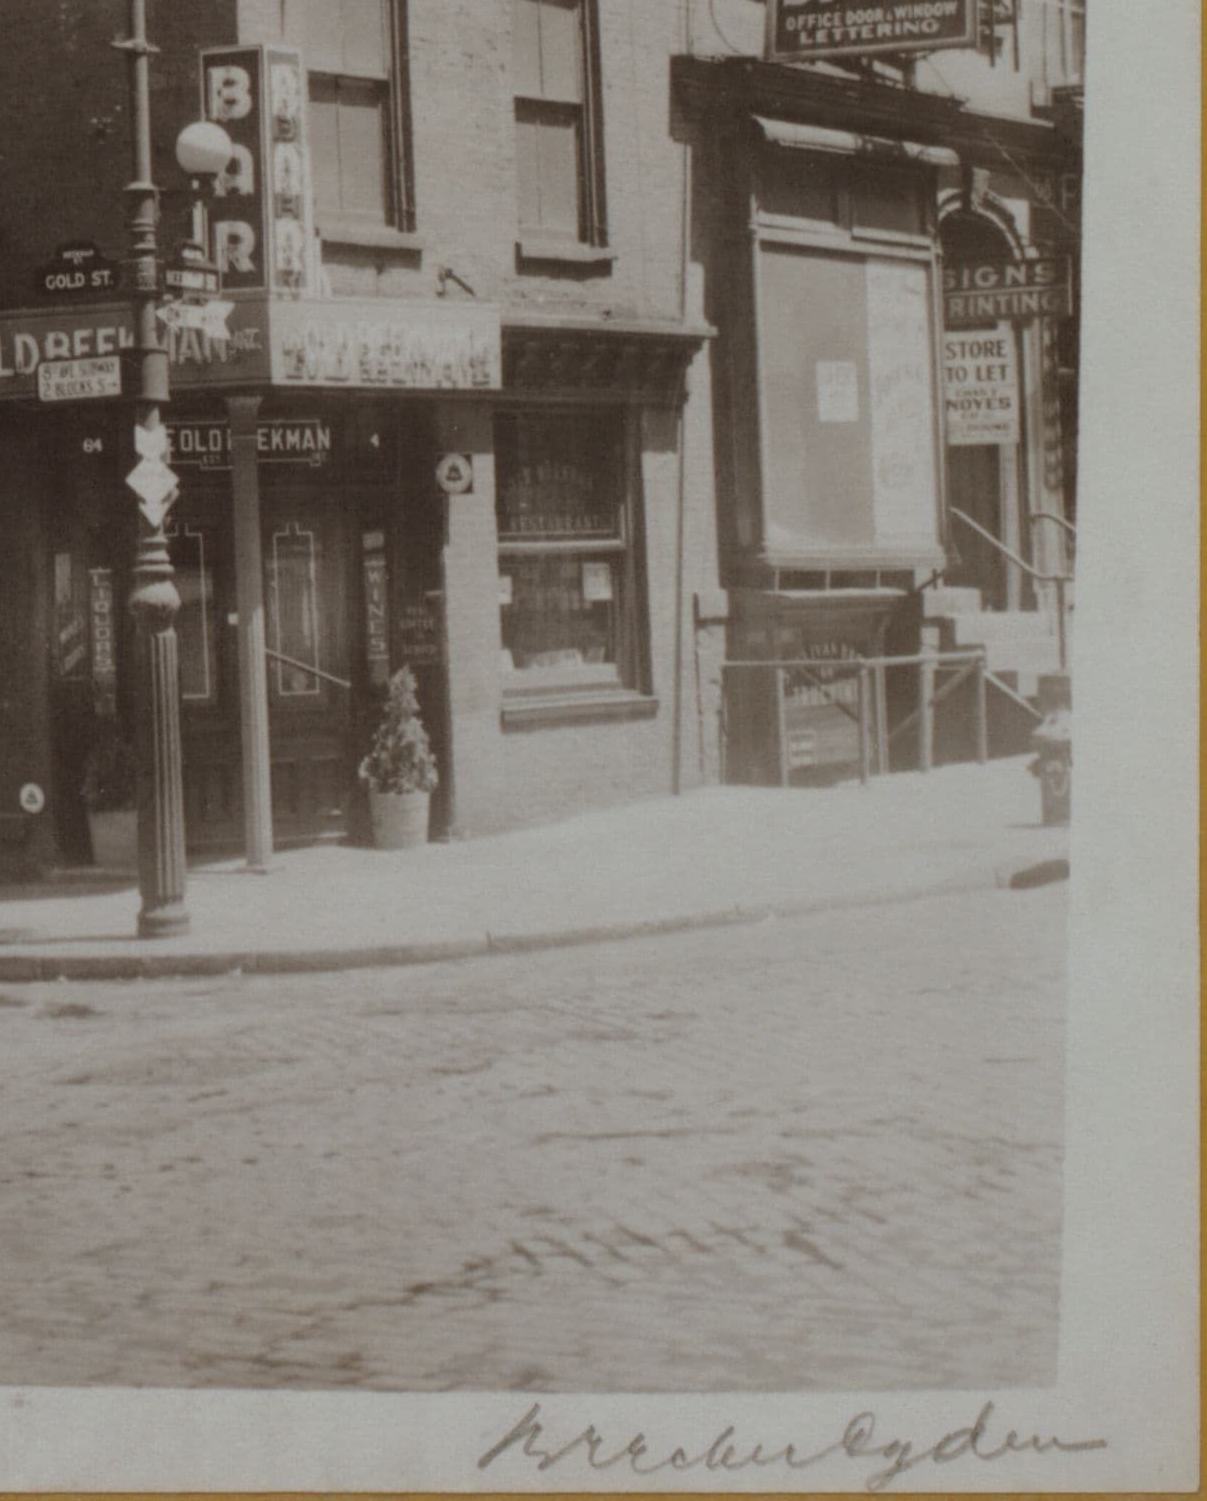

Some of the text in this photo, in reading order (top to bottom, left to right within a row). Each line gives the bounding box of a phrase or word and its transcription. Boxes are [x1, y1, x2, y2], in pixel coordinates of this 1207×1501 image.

[785, 11, 843, 31] OFFICE
[846, 6, 885, 26] DOOR
[894, 0, 958, 21] WINDOW
[799, 17, 941, 45] LETTERING
[45, 272, 85, 291] GOLD
[943, 263, 1055, 289] SIGNS
[947, 292, 1061, 318] RINTING
[945, 340, 1007, 360] STORE
[946, 364, 1009, 383] TO LET
[83, 437, 102, 453] 64
[180, 429, 222, 452] OLD
[837, 1401, 1108, 1491] Ogden
